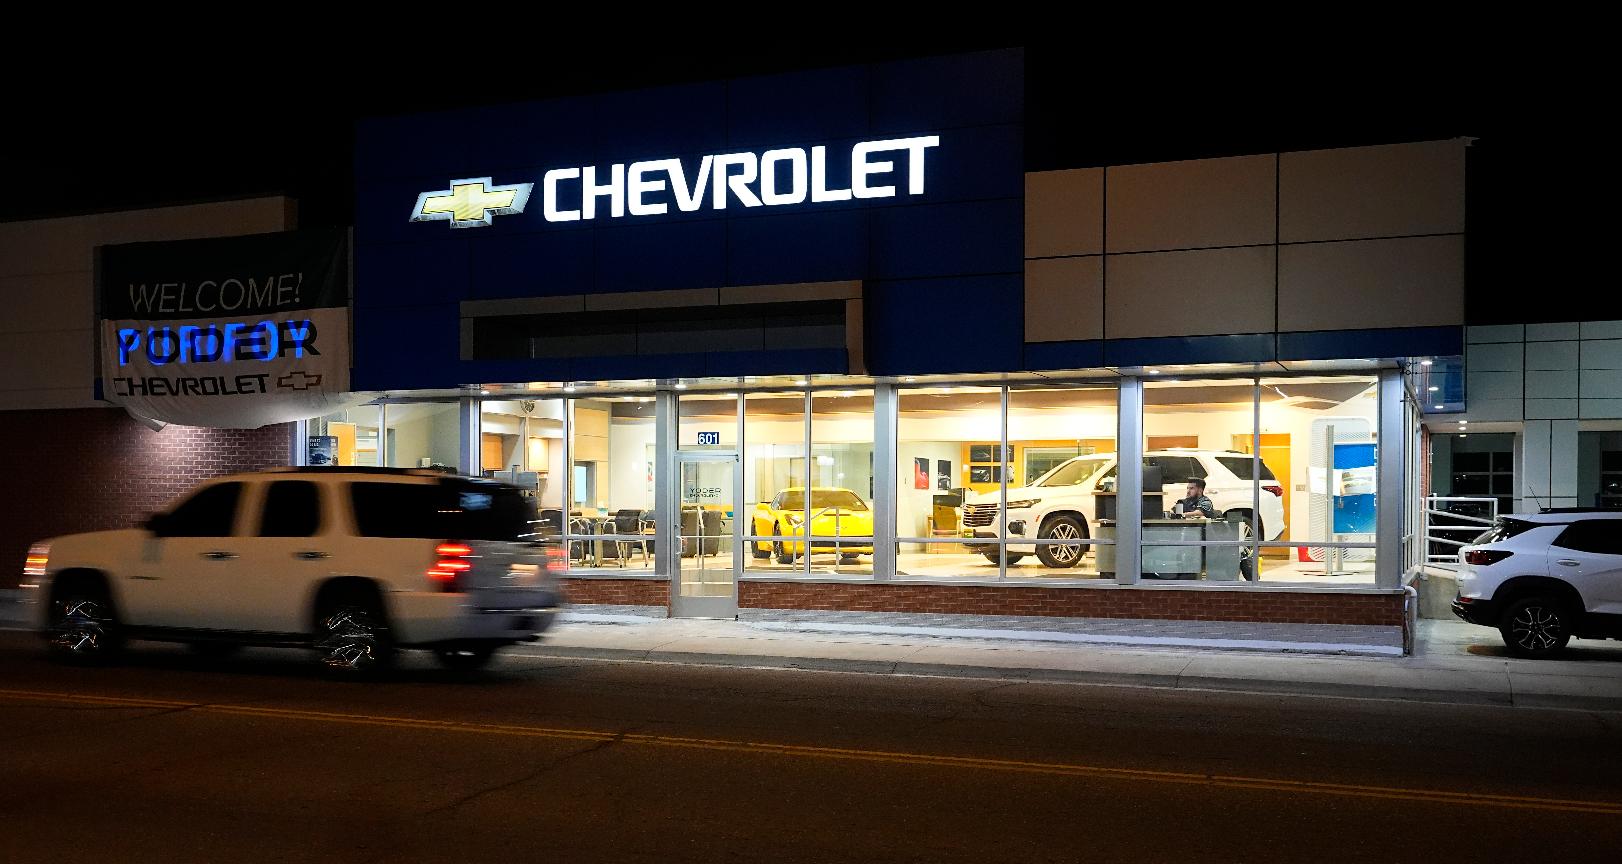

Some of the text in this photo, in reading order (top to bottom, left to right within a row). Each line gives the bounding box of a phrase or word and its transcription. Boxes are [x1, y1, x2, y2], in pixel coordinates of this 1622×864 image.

[543, 135, 940, 222] CHEVROLET
[129, 272, 303, 313] WELCOME!
[113, 373, 270, 397] CHEVROLET
[698, 432, 718, 445] 601
